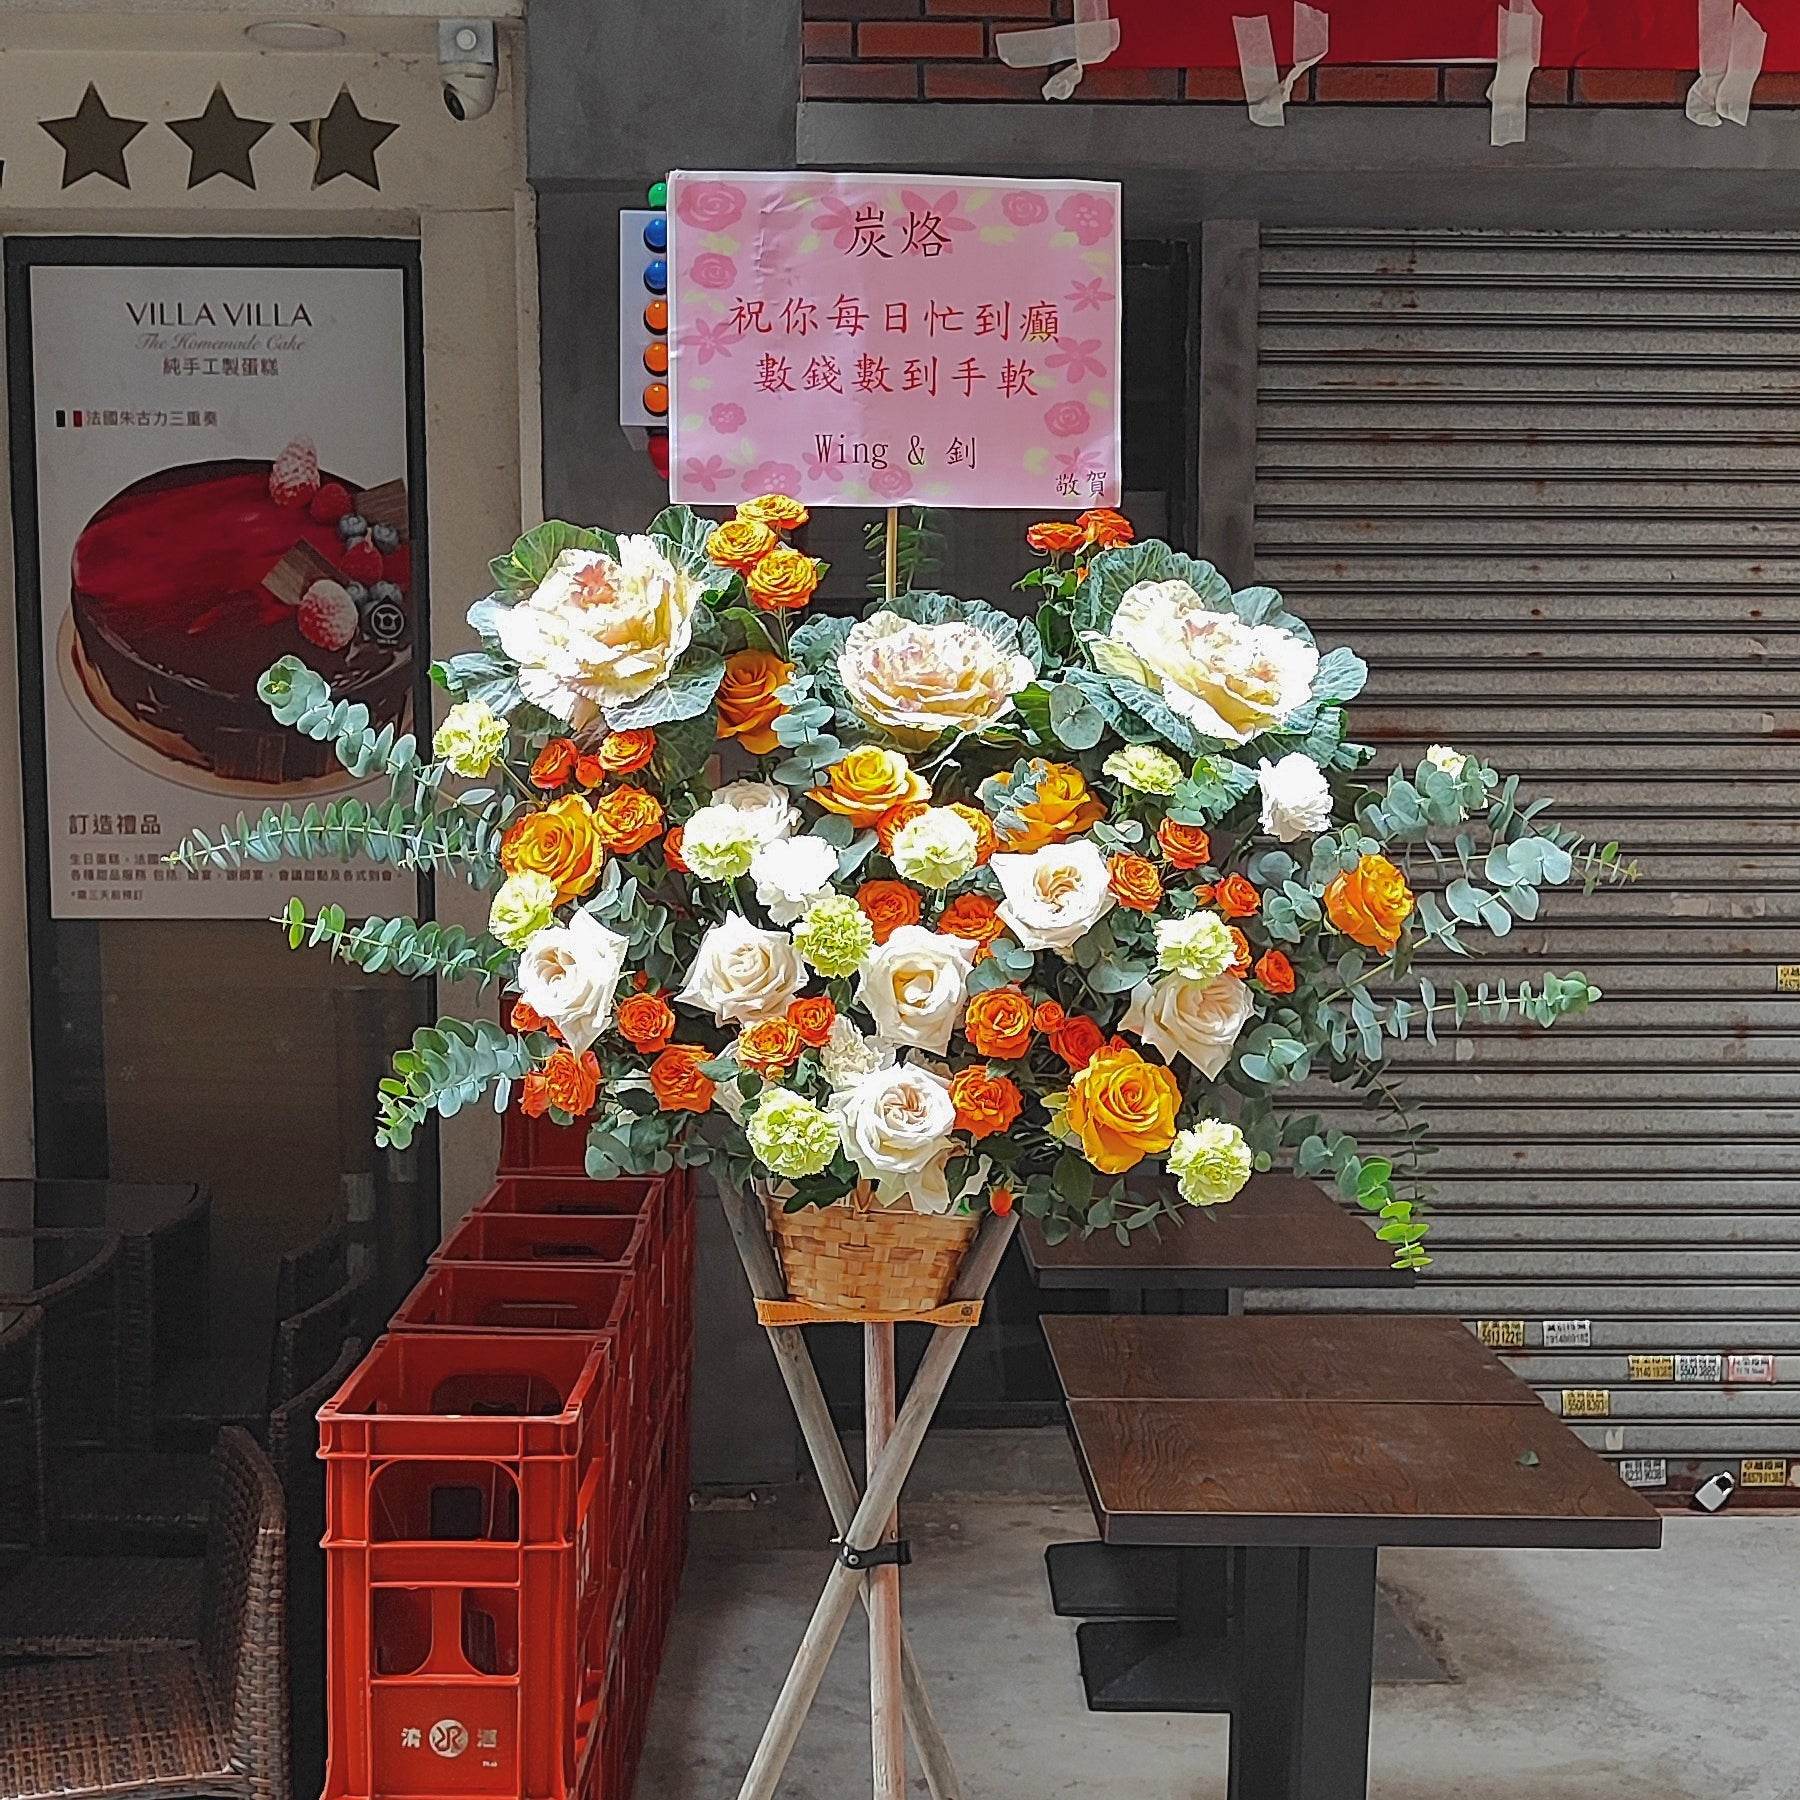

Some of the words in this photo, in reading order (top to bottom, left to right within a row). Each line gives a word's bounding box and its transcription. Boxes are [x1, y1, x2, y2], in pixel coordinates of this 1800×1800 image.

[845, 207, 952, 258] 炭烙
[126, 302, 216, 326] VILLA
[222, 302, 312, 327] VILLA
[727, 293, 1060, 344] 祝你每日忙到癲
[135, 332, 168, 350] The
[266, 333, 305, 351] Cake
[753, 352, 1040, 399] 數錢數到手軟
[814, 433, 889, 470] Wing
[907, 434, 926, 466] &
[945, 436, 977, 470] 釗
[1055, 470, 1107, 498] 敬賀
